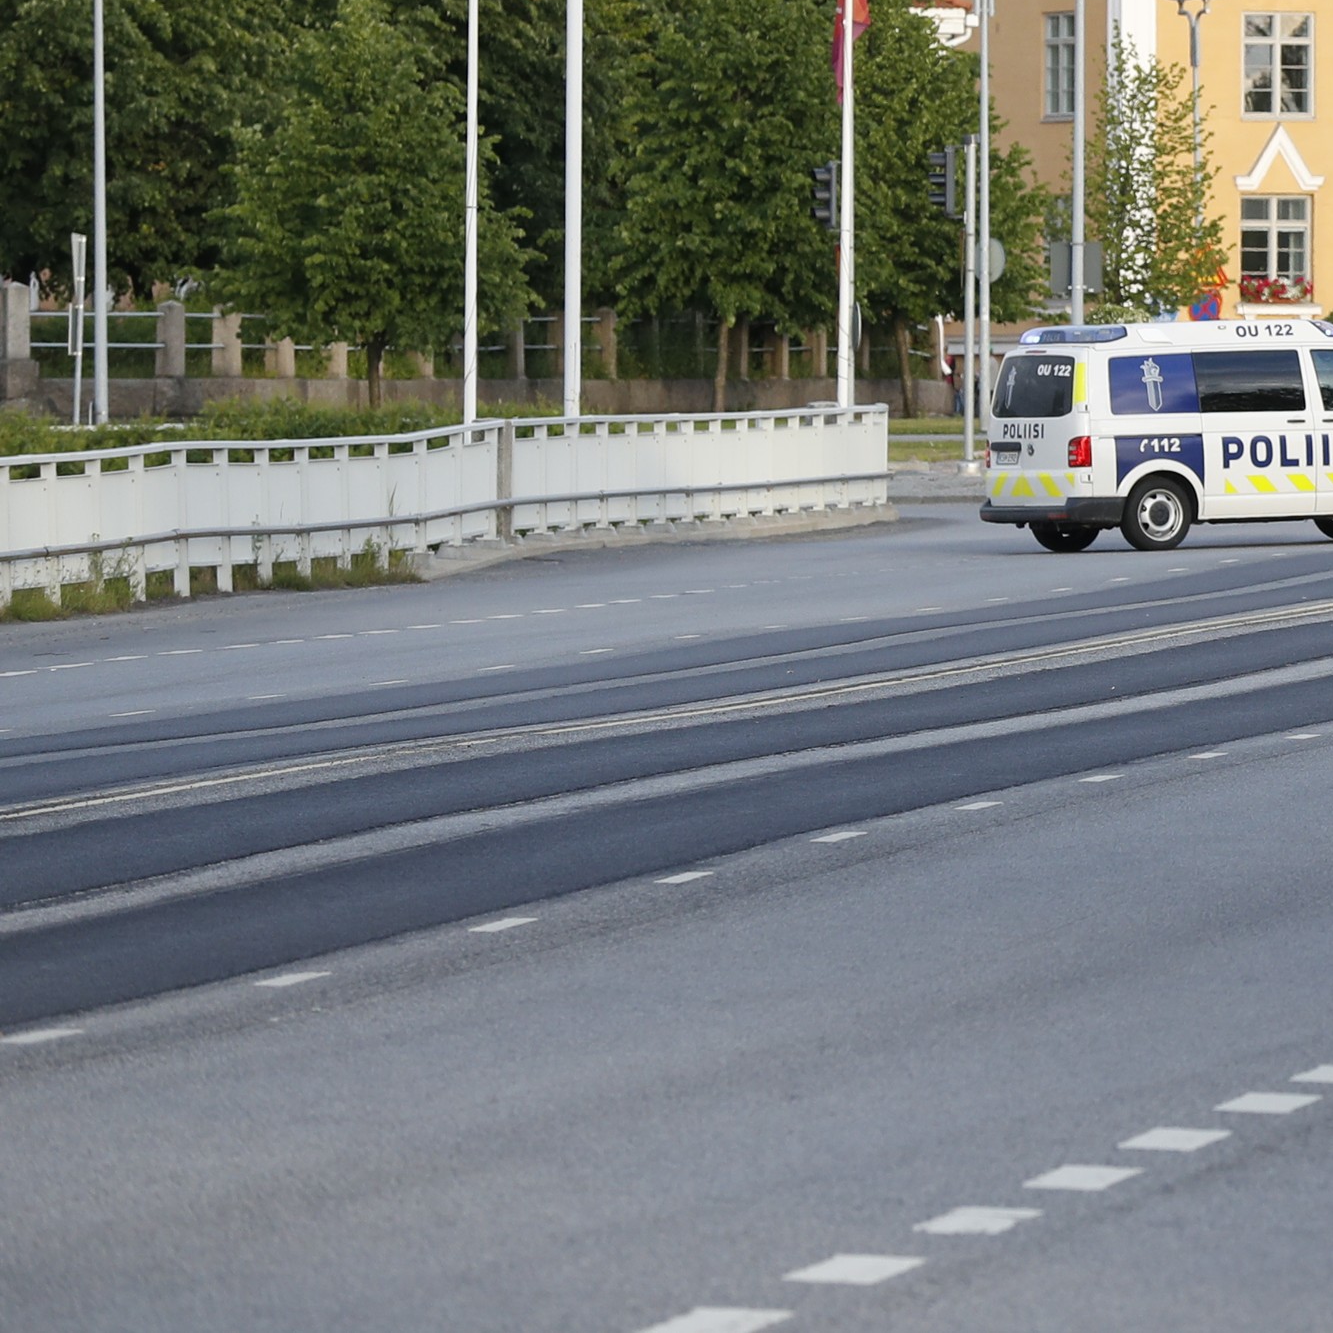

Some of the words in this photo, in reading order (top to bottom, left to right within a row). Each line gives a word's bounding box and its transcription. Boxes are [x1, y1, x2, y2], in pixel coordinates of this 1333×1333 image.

[1235, 325, 1259, 338] OU
[1264, 323, 1294, 337] 122
[1036, 364, 1052, 377] OU
[1053, 364, 1072, 377] 122
[1002, 423, 1045, 440] POLIISI
[1150, 437, 1181, 453] 112
